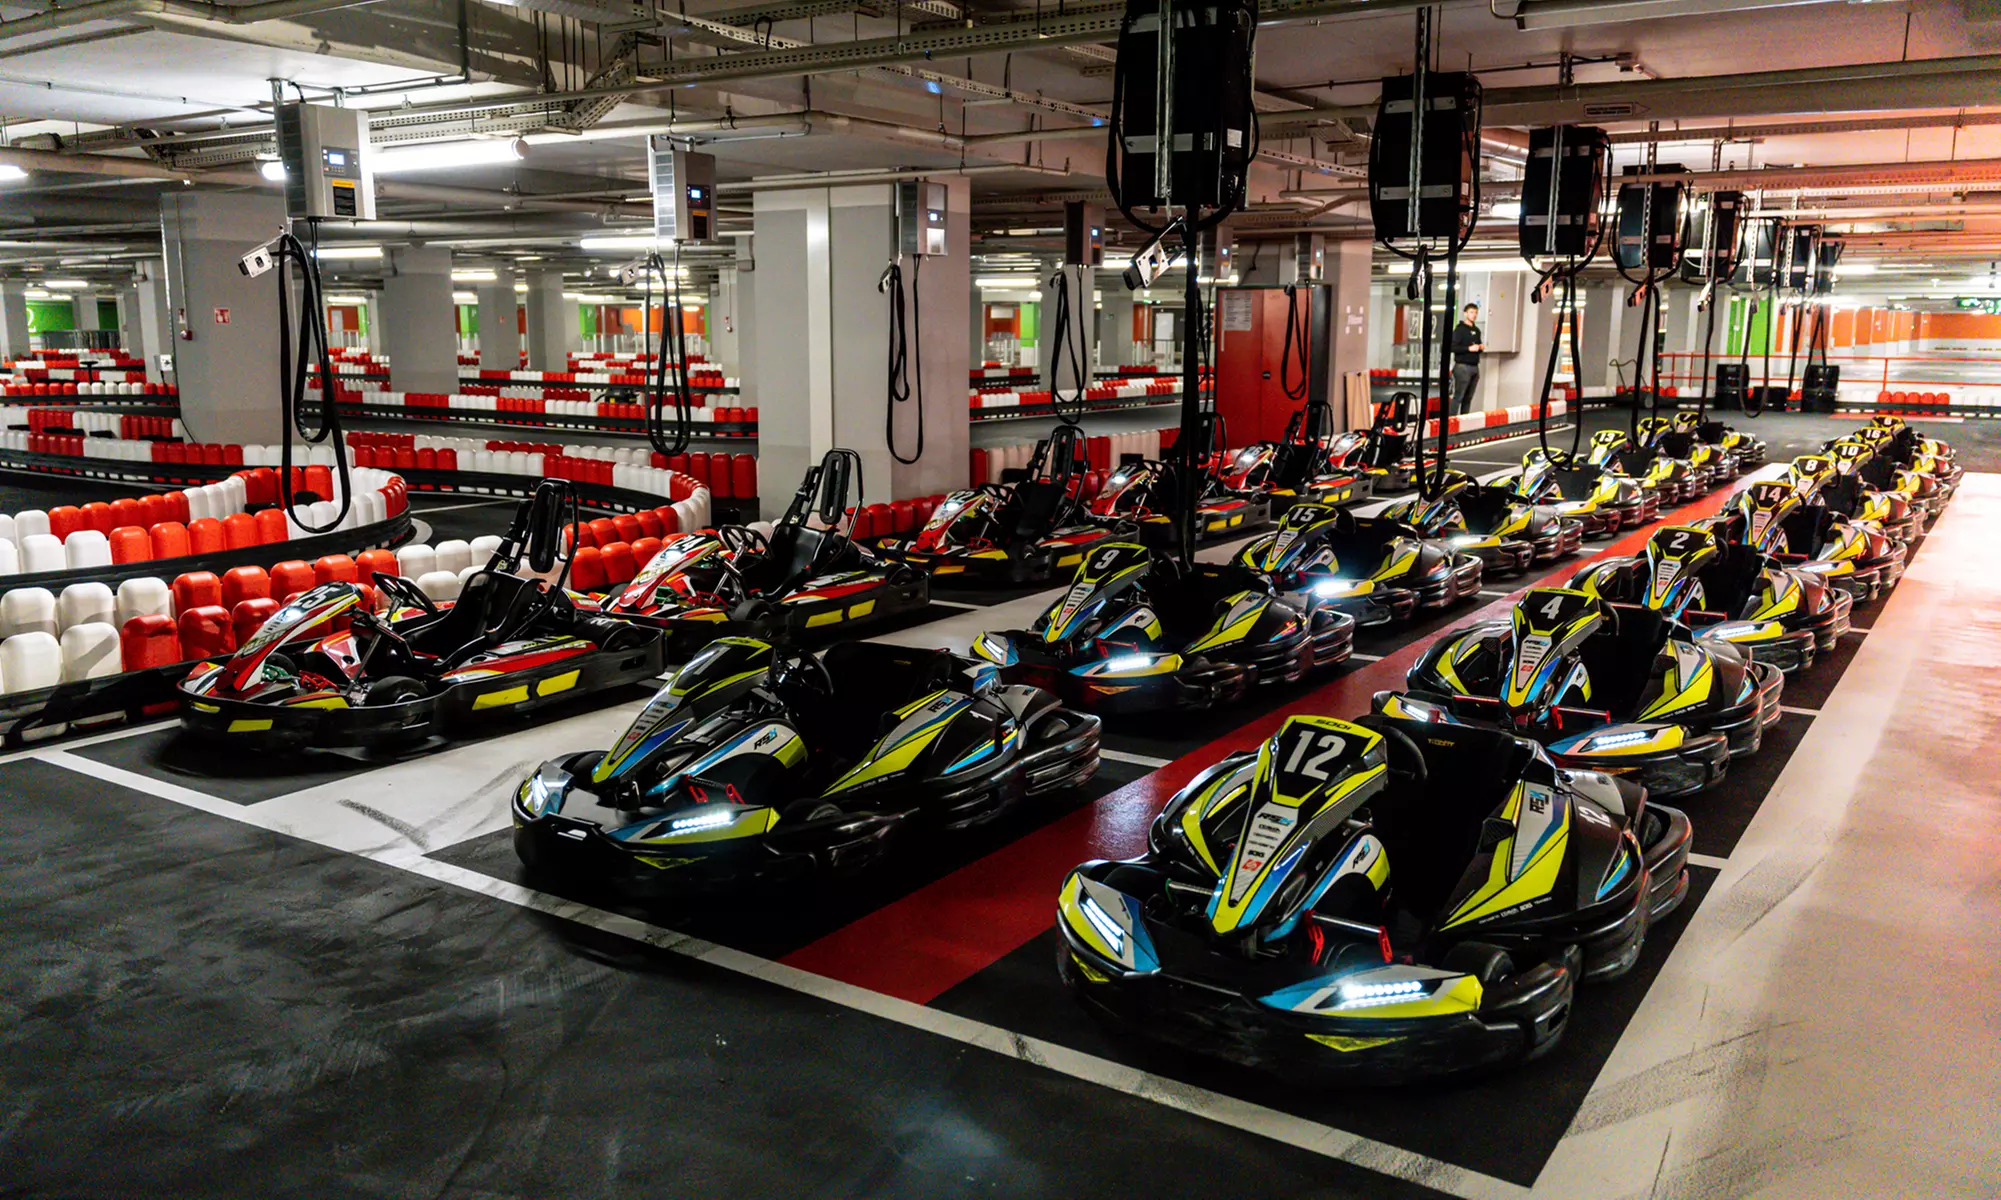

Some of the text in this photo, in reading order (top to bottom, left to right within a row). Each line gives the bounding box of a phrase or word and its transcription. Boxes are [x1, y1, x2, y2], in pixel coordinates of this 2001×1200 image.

[1599, 433, 1615, 442] 13
[1866, 429, 1881, 439] 16
[1841, 446, 1859, 456] 10
[1805, 459, 1818, 471] 8
[1759, 485, 1783, 501] 14
[1292, 507, 1318, 522] 15
[671, 535, 706, 551] 24
[1669, 531, 1690, 549] 2
[1094, 549, 1120, 569] 9
[290, 585, 340, 609] 25
[1540, 595, 1564, 619] 4
[694, 646, 731, 675] 1
[754, 727, 778, 751] RSX
[1284, 730, 1347, 781] 12
[1529, 789, 1549, 814] RSX
[1578, 806, 1611, 828] 12
